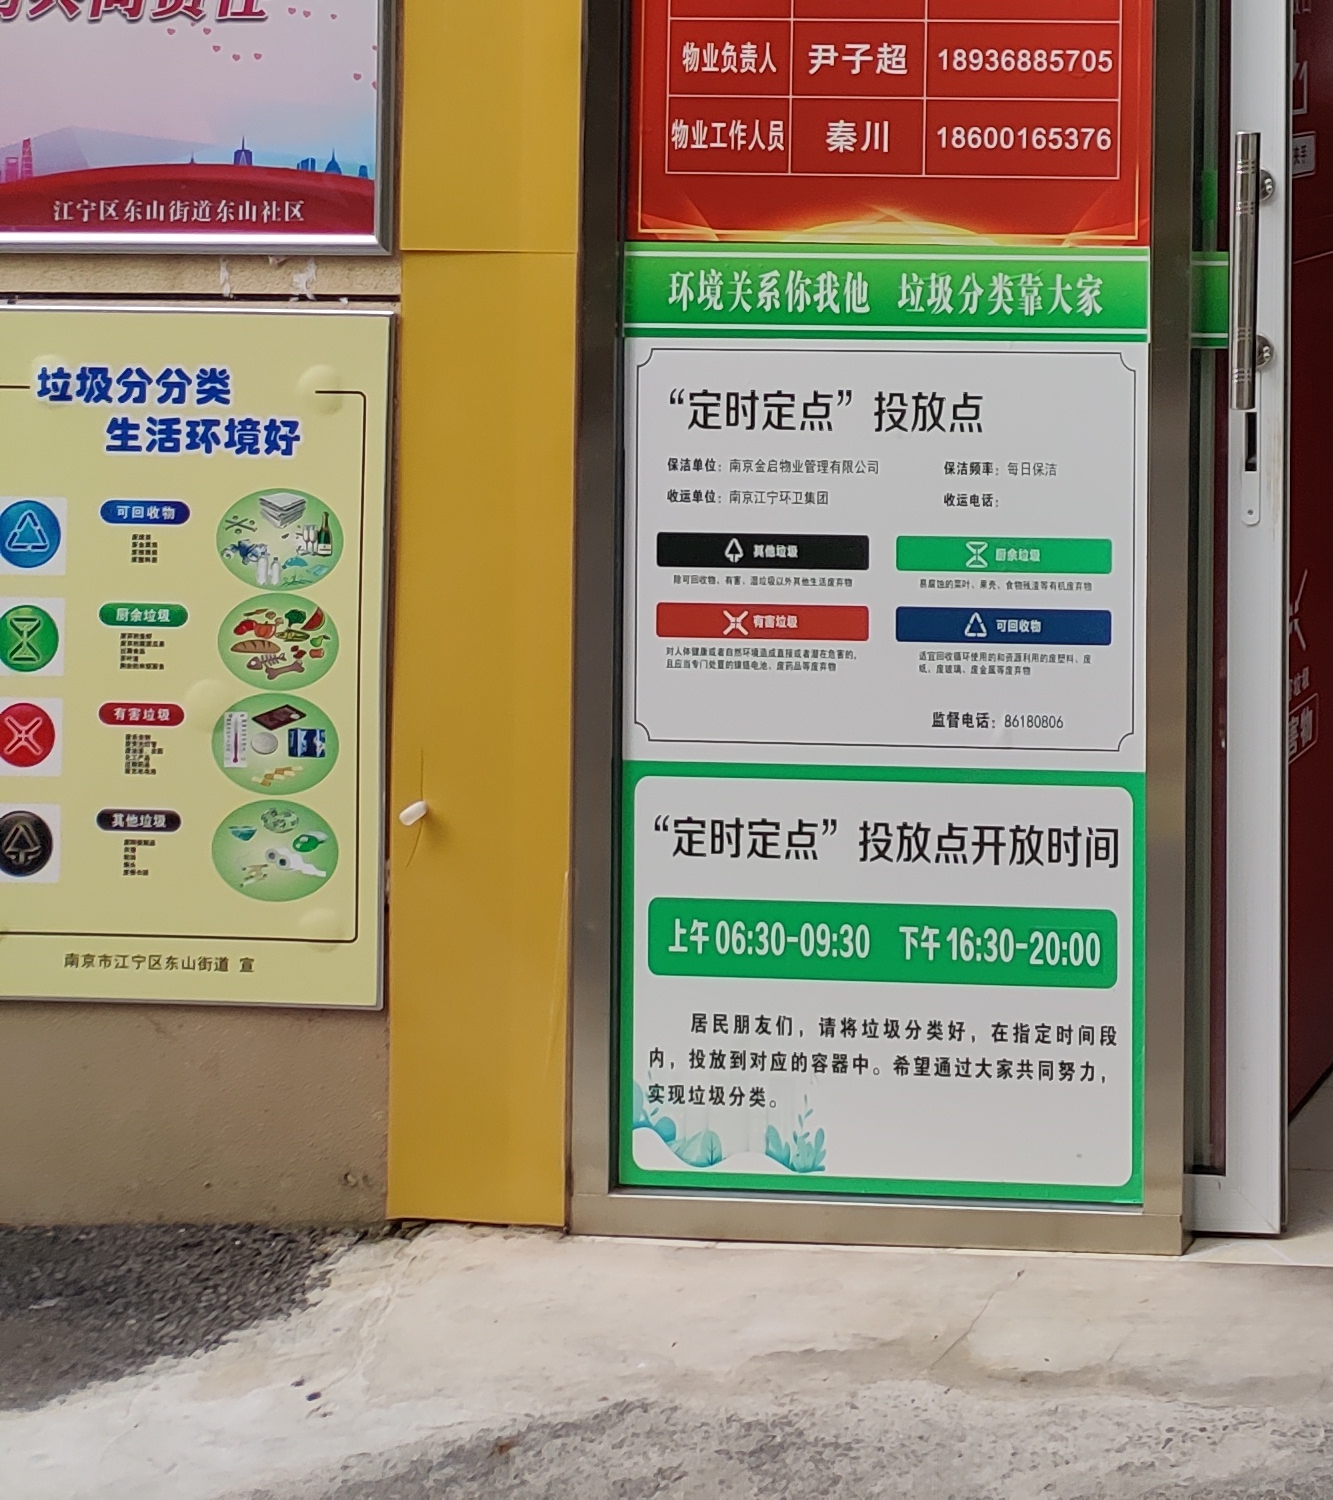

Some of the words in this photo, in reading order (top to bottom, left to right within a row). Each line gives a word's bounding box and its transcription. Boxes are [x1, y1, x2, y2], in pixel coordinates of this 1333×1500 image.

[683, 42, 777, 75] 物业负责人
[808, 43, 908, 75] 尹子超
[937, 48, 1113, 73] 18936885705
[671, 119, 784, 152] 物业工作人员
[826, 120, 890, 153] 秦川
[936, 126, 1111, 151] 18600165376
[53, 200, 305, 223] 江宁区东山街道东山社区
[668, 269, 870, 314] 环境关系你我他
[898, 272, 1104, 317] 垃圾分类靠大家
[37, 366, 231, 405] 垃圾分分类
[106, 417, 301, 456] 生活环境好
[116, 505, 176, 521] 可回收物
[753, 543, 799, 560] 其他垃圾
[995, 547, 1041, 563] 厨余垃圾
[116, 607, 170, 623] 厨余垃圾
[753, 615, 799, 630] 有害垃圾
[996, 618, 1042, 634] 可回收物
[114, 707, 170, 723] 有害垃圾
[111, 813, 167, 829] 其他垃圾
[64, 953, 229, 973] 南京市江宁区东山街道
[239, 957, 256, 973] 宣
[690, 1012, 1118, 1047] 居民朋友们，请将垃圾分类好，在指定时间段
[648, 1048, 1108, 1084] 内，投放到对应的容器中。希望通过大家共同努力，
[647, 1083, 780, 1109] 实现垃圾分类。
